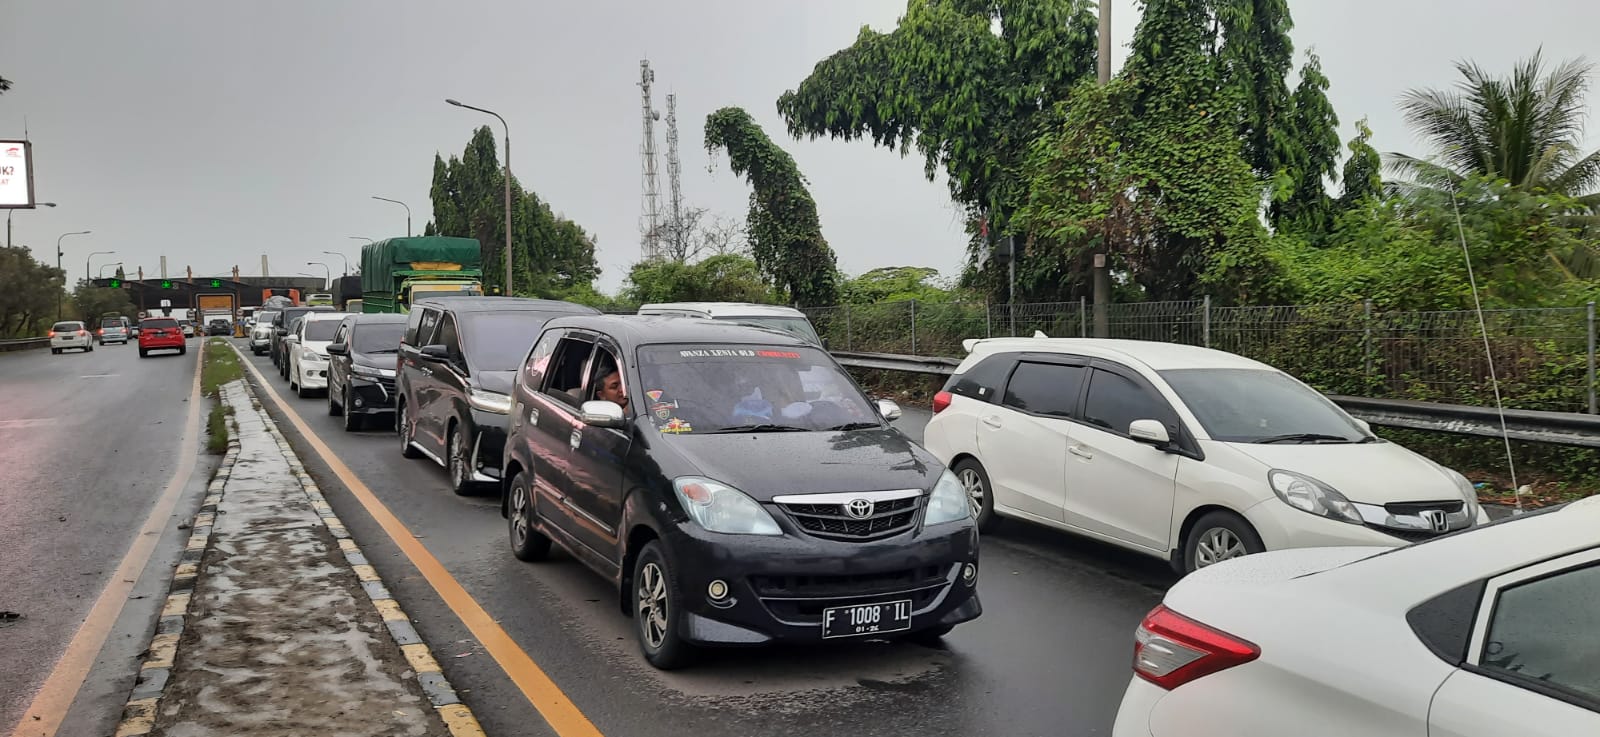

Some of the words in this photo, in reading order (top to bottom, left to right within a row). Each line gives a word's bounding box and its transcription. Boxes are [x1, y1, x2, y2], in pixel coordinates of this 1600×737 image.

[826, 610, 835, 628] F
[850, 606, 881, 625] 1008
[895, 603, 909, 620] IL
